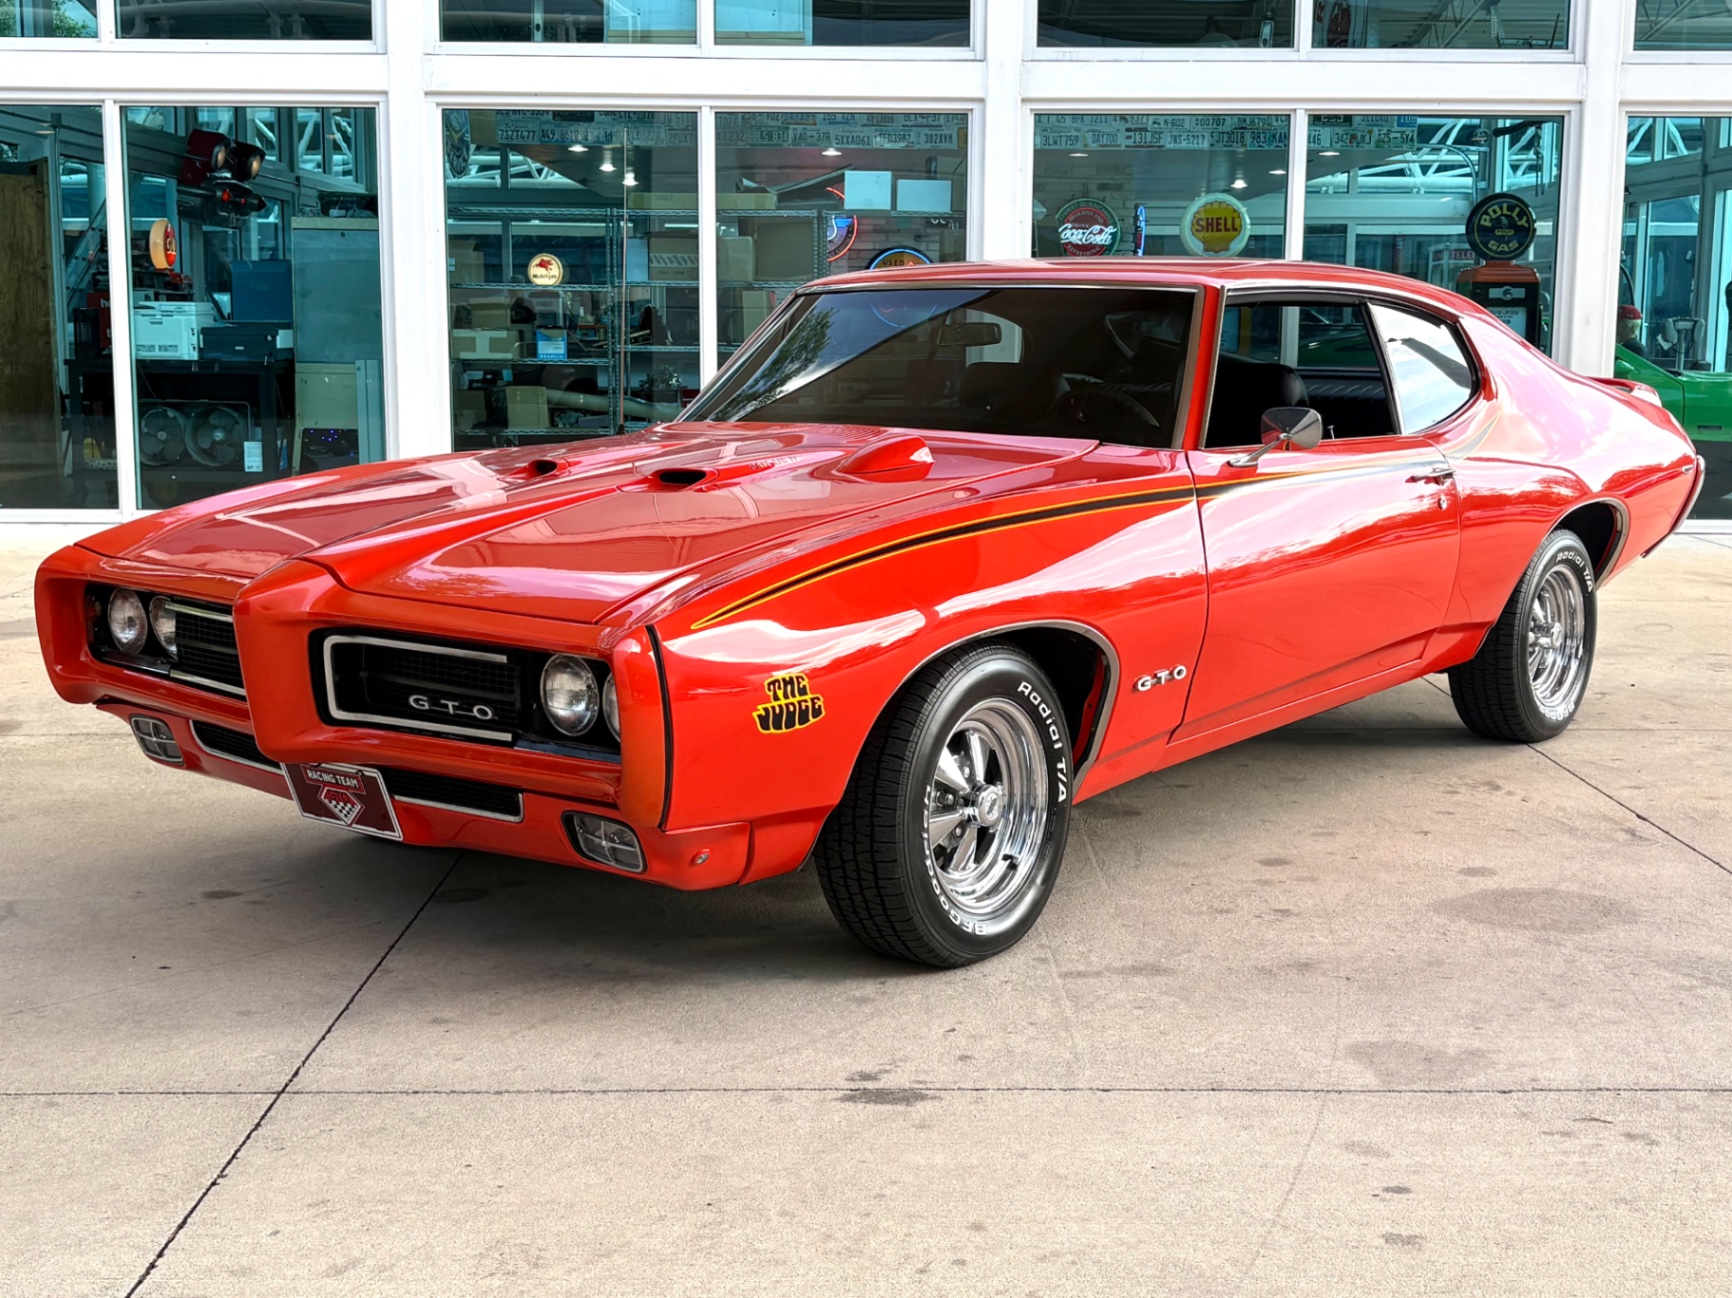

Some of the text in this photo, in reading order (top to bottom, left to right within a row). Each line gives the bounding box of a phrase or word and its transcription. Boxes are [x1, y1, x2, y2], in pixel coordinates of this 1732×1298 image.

[1195, 216, 1239, 233] SHELL
[1480, 203, 1529, 228] POLLY
[1488, 240, 1519, 252] GAS
[766, 674, 810, 702] THE
[1136, 664, 1188, 692] GTO
[408, 694, 493, 720] GTO
[755, 696, 823, 732] JUDGE
[1017, 681, 1063, 750] Radial
[306, 769, 359, 788] RACING TEAM
[1056, 756, 1068, 803] T/A
